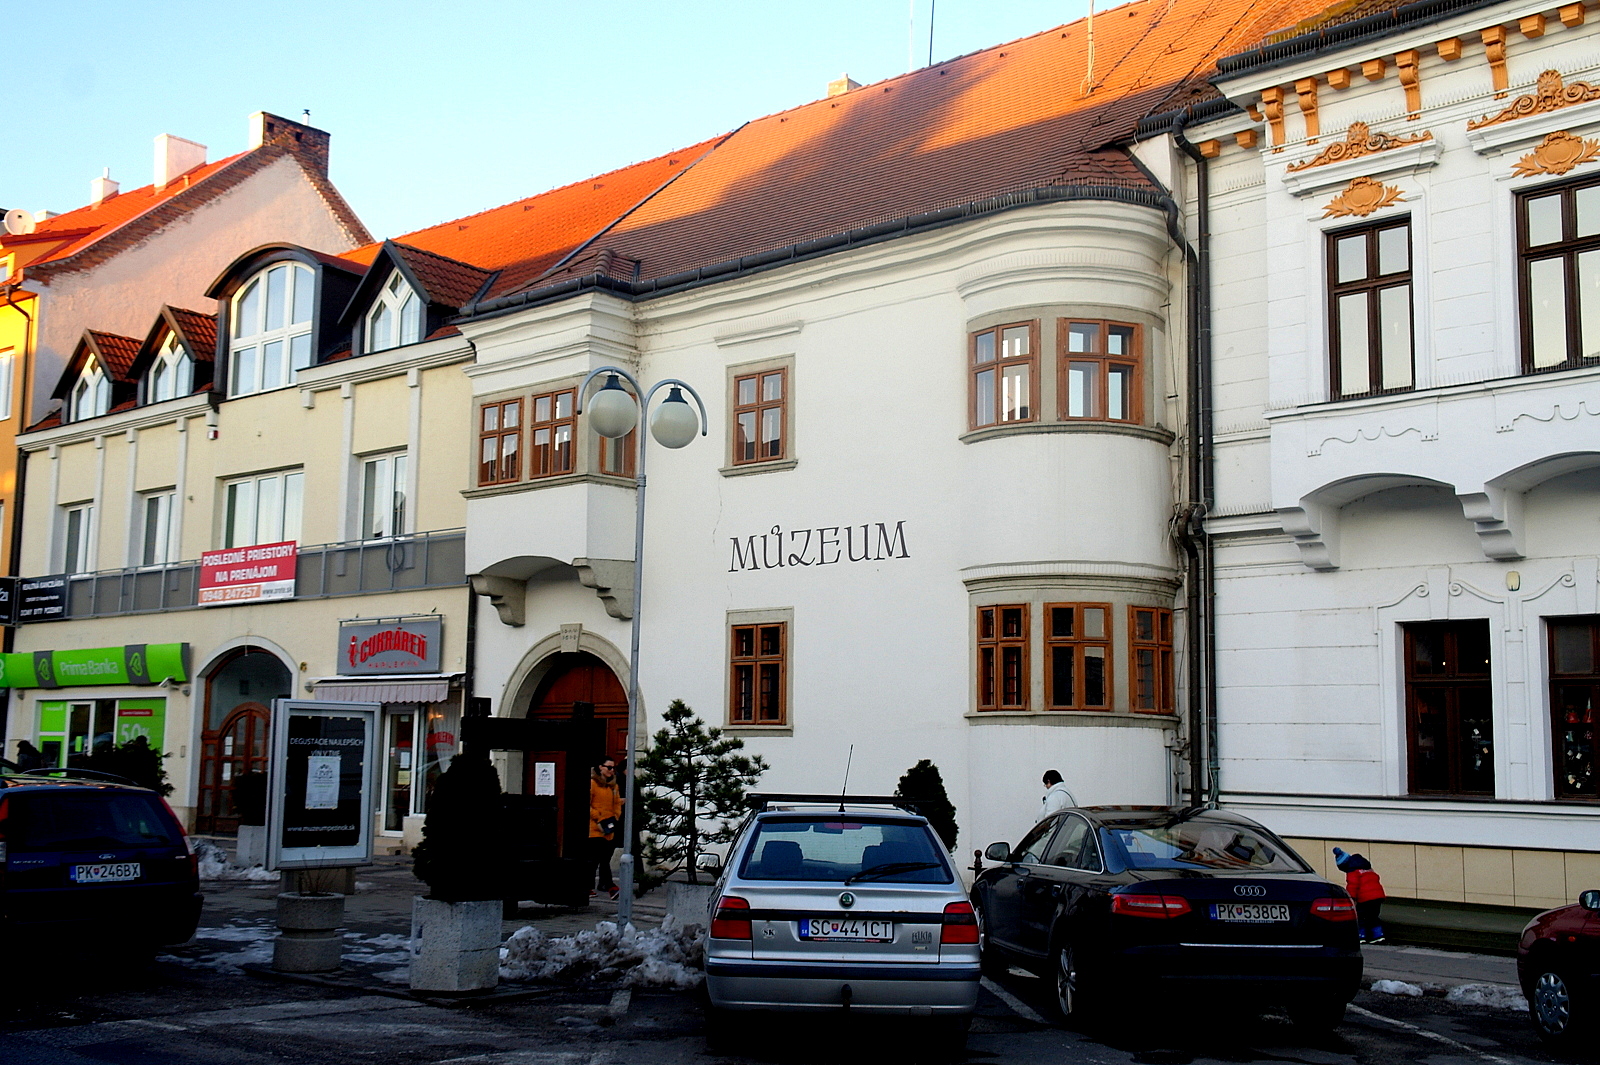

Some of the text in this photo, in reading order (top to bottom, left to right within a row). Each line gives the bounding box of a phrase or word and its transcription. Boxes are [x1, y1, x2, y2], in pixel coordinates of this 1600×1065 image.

[203, 544, 295, 566] POSLEDNÉ PRIESTORY
[215, 565, 278, 582] NA PRENÁJOM
[225, 587, 258, 600] 247257
[359, 627, 427, 663] CUKRÁREŇ
